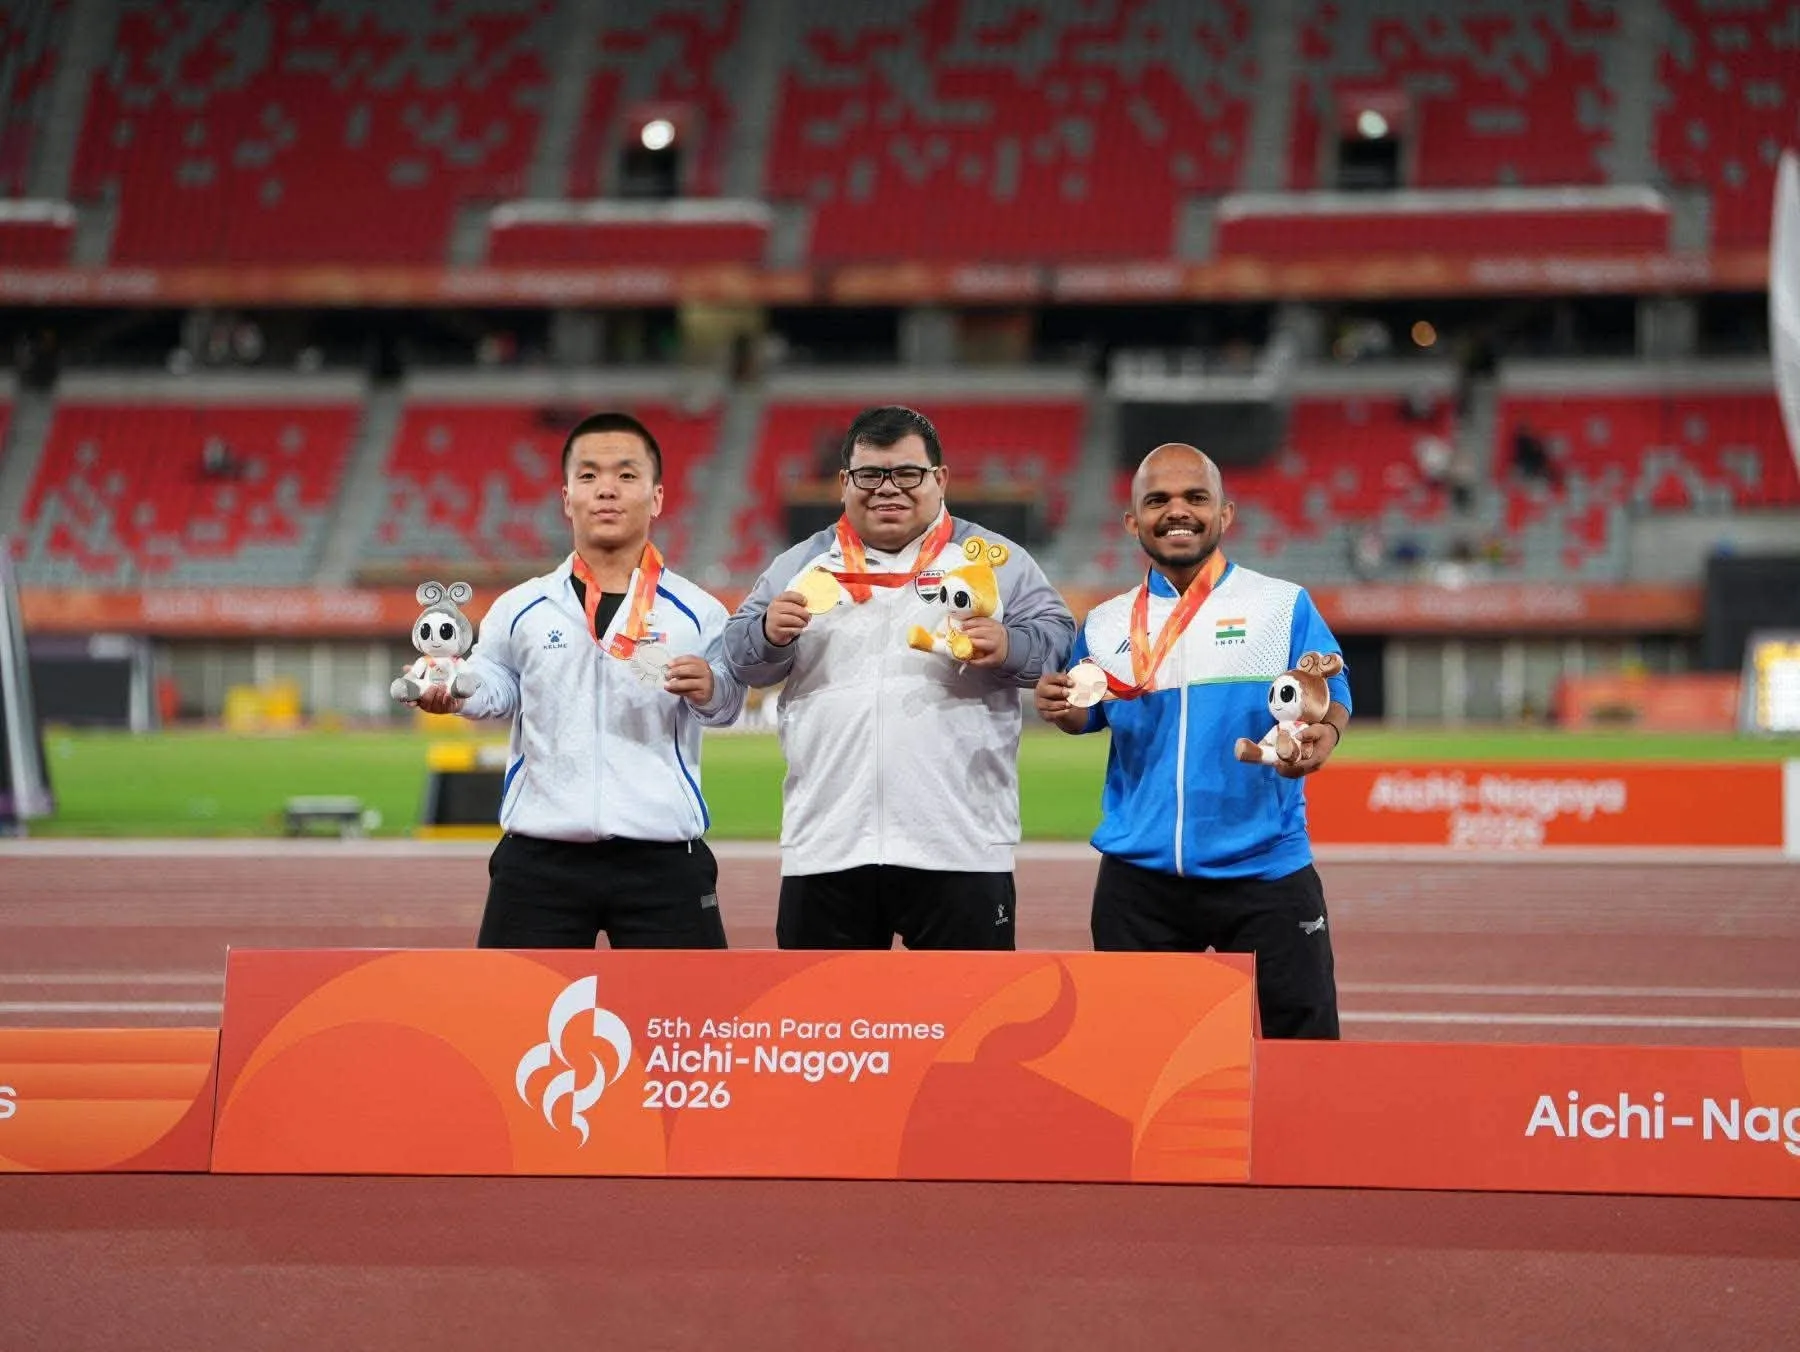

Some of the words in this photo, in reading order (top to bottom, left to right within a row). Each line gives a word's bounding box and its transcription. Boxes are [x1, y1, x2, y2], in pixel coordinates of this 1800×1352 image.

[646, 1016, 691, 1039] 5th
[699, 1016, 771, 1039] Asian
[780, 1018, 842, 1039] Para
[850, 1018, 945, 1040] Games
[644, 1042, 890, 1083] Aichi-Nagoya
[642, 1080, 731, 1109] 2026
